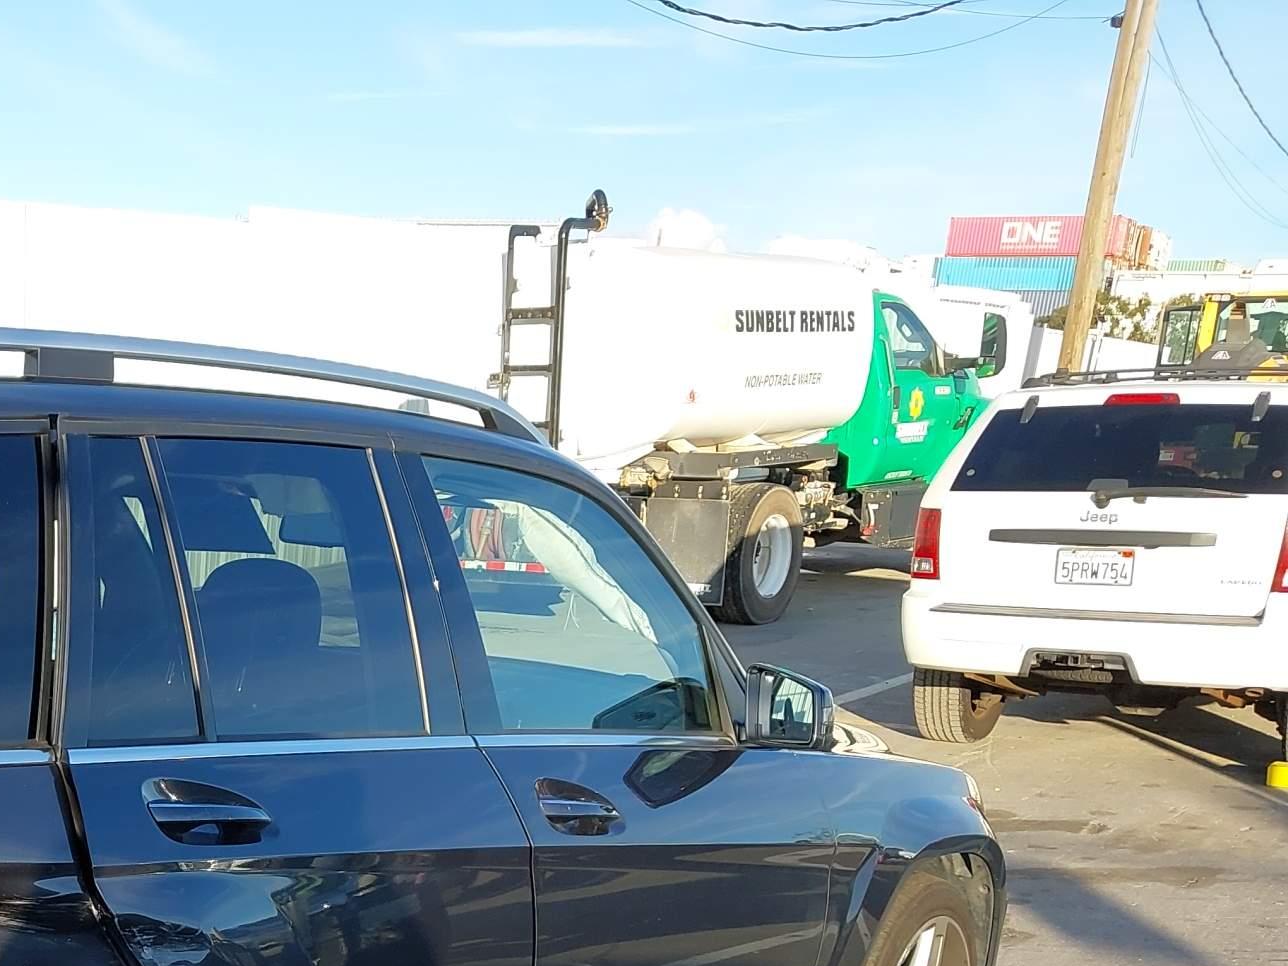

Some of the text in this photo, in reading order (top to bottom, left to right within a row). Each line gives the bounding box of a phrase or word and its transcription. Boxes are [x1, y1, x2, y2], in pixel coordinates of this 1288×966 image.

[1000, 221, 1063, 242] ONE
[735, 309, 855, 333] SUNBELT RENTALS
[744, 372, 823, 388] NON-POTABLE WATER
[1079, 510, 1118, 525] Jeep
[1061, 561, 1128, 580] 5PRW754
